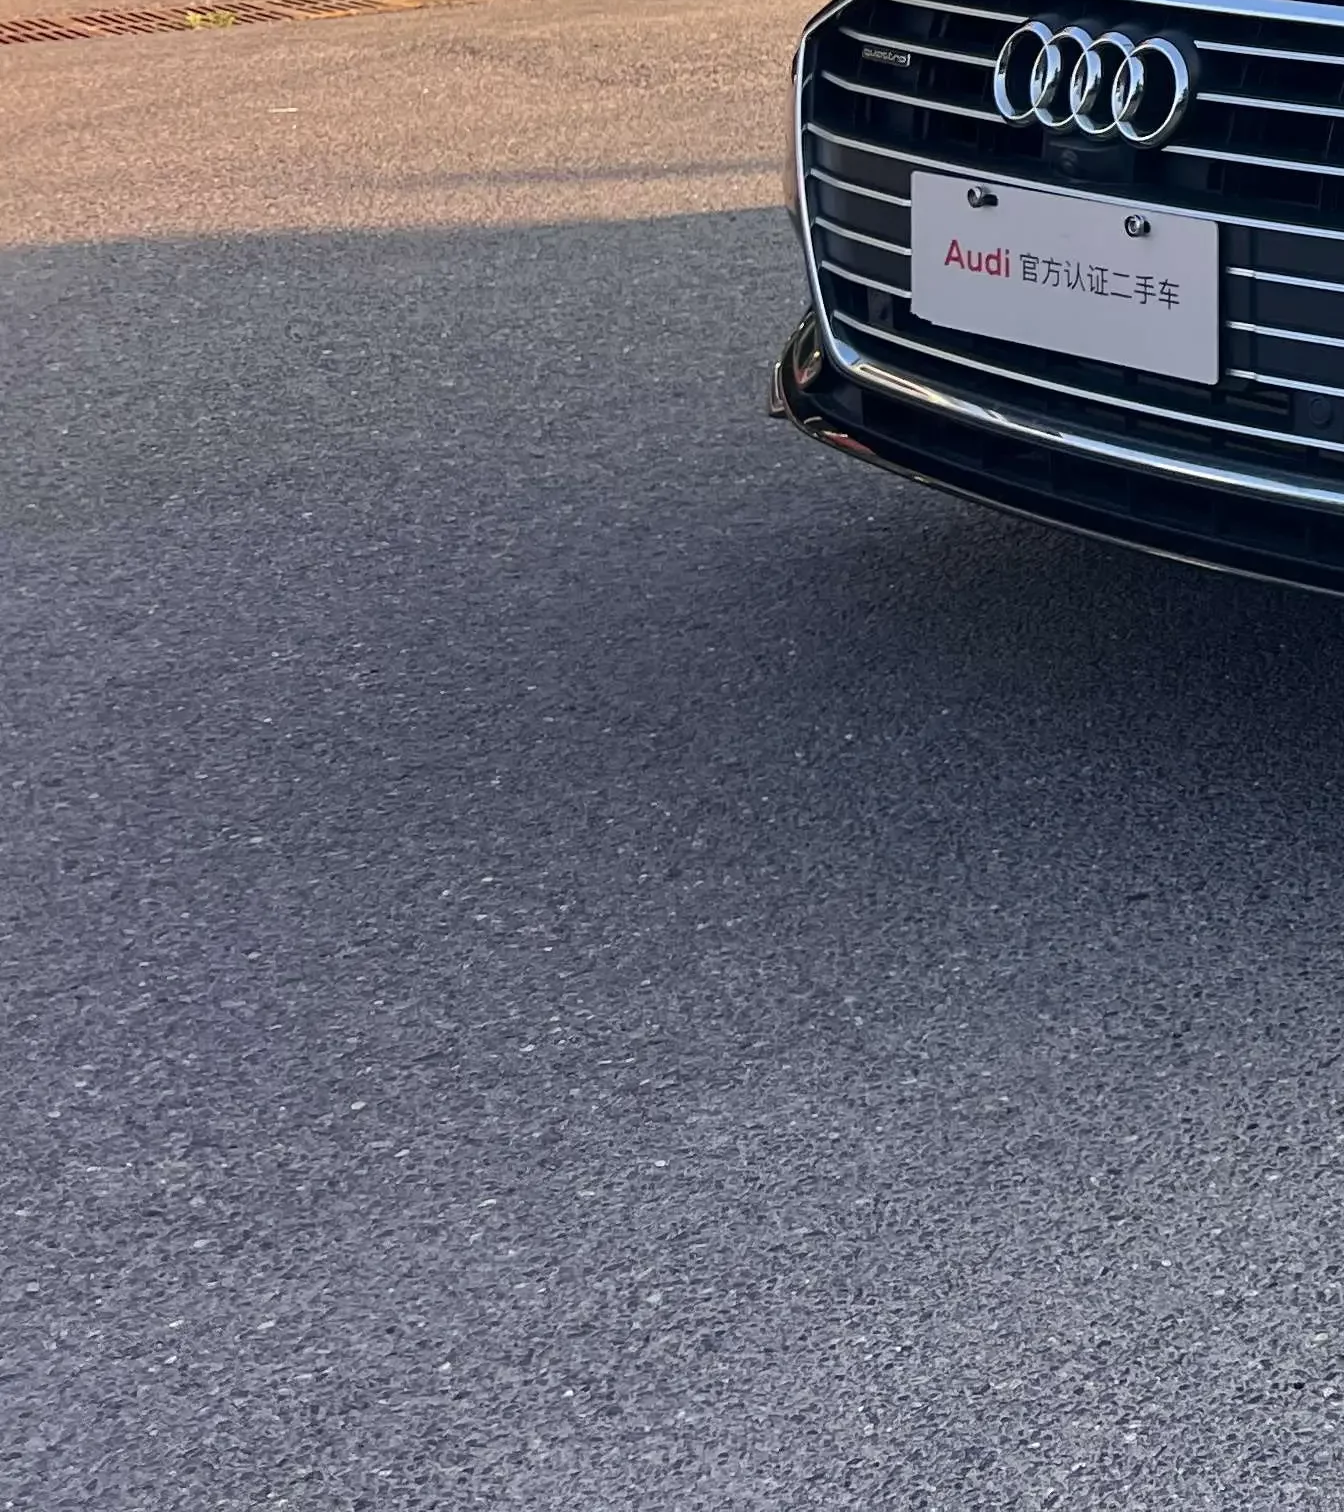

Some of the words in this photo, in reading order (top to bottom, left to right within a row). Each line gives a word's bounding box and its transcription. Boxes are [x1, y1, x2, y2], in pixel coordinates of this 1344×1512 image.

[944, 239, 1010, 278] Audi
[1019, 252, 1180, 310] 官方认证二手车
